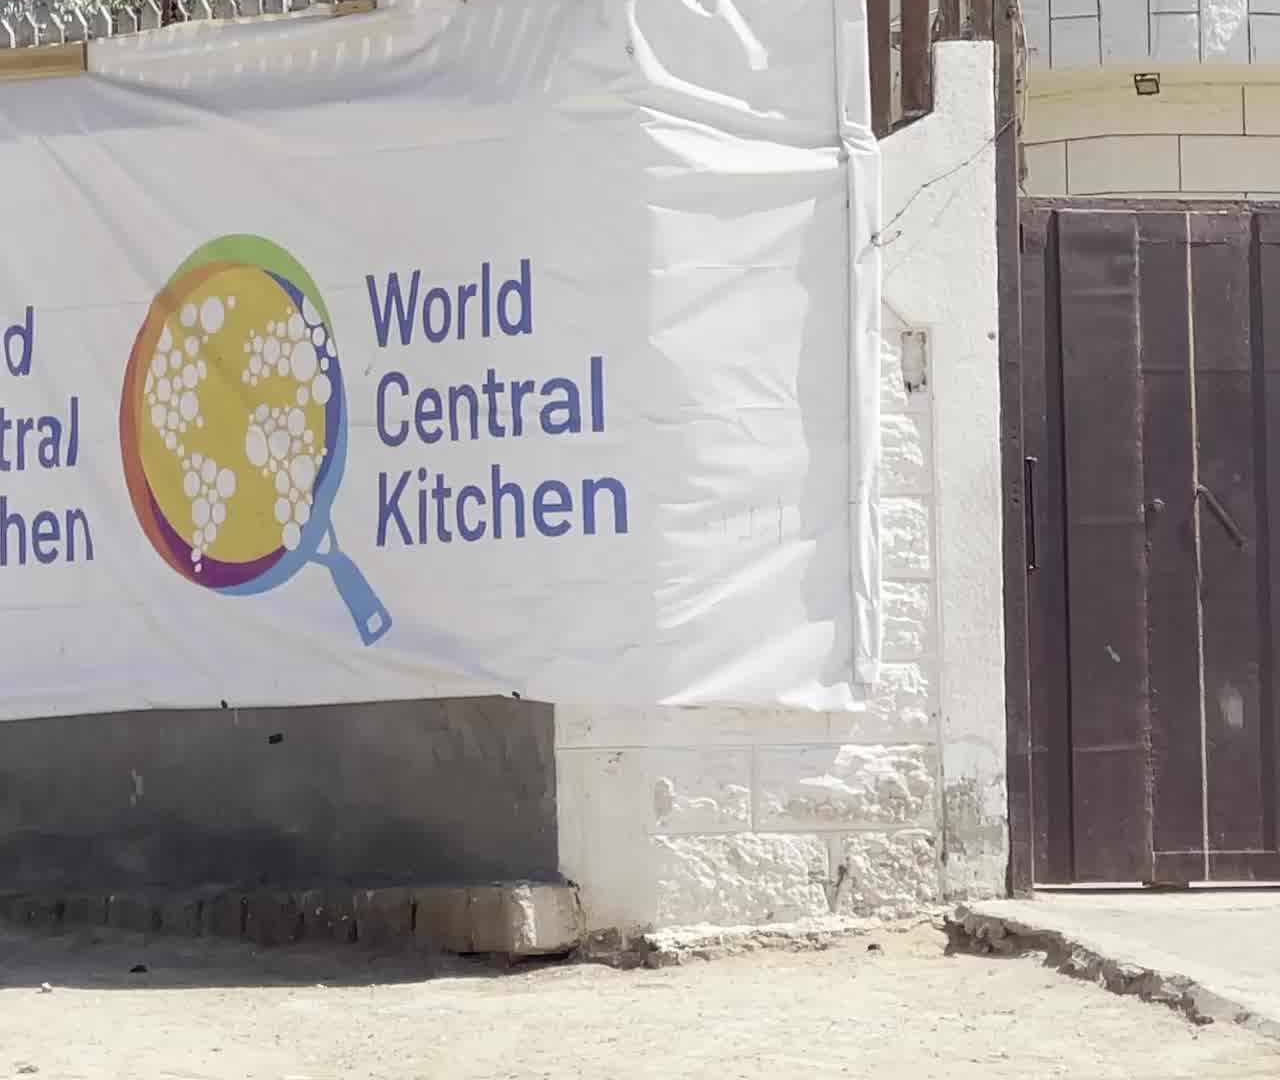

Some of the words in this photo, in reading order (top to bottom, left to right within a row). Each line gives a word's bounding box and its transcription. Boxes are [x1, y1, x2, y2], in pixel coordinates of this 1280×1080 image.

[365, 258, 532, 348] World
[376, 356, 605, 447] Central
[376, 464, 628, 547] Kitchen
